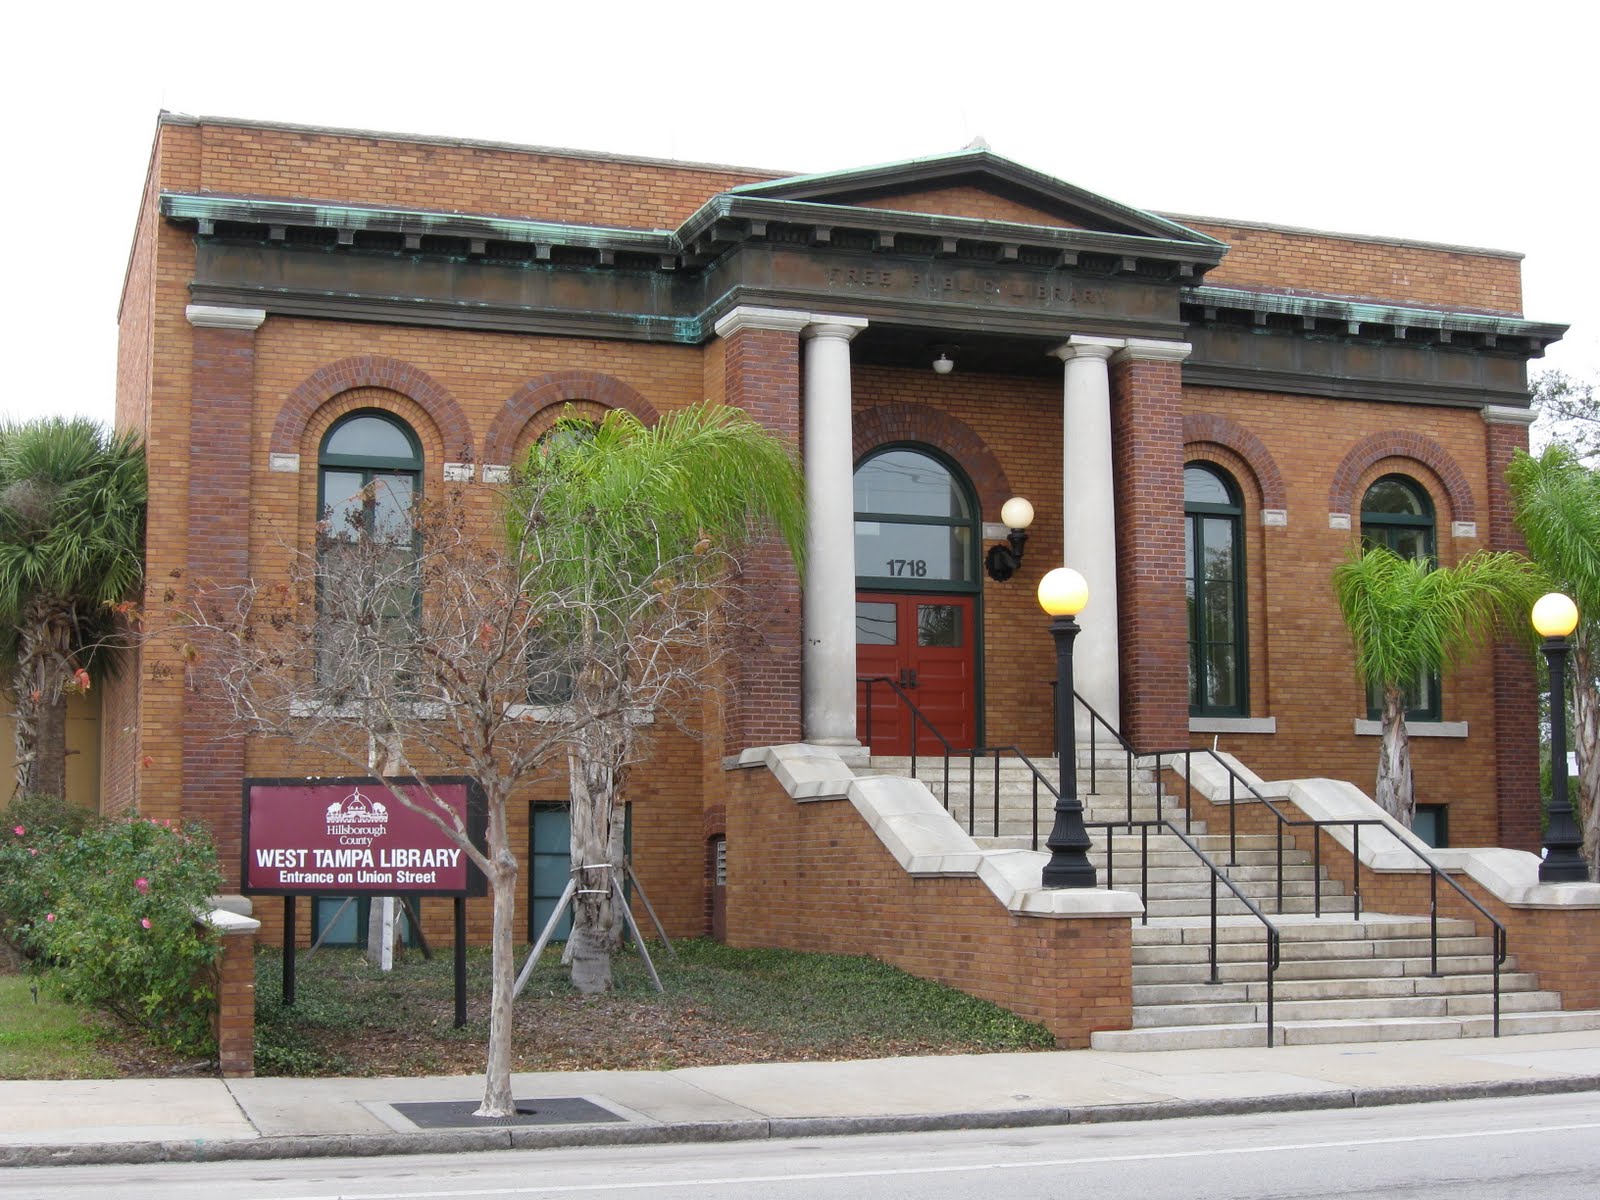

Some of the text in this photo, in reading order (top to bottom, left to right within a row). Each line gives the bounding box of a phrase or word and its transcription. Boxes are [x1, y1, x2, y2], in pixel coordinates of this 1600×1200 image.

[828, 267, 893, 288] FREE
[886, 559, 927, 577] 1718
[327, 825, 386, 837] Hillsborough
[339, 836, 373, 847] County
[256, 849, 462, 868] WEST TAMPA LIBRARY
[279, 871, 436, 883] Entrance on Union Street
